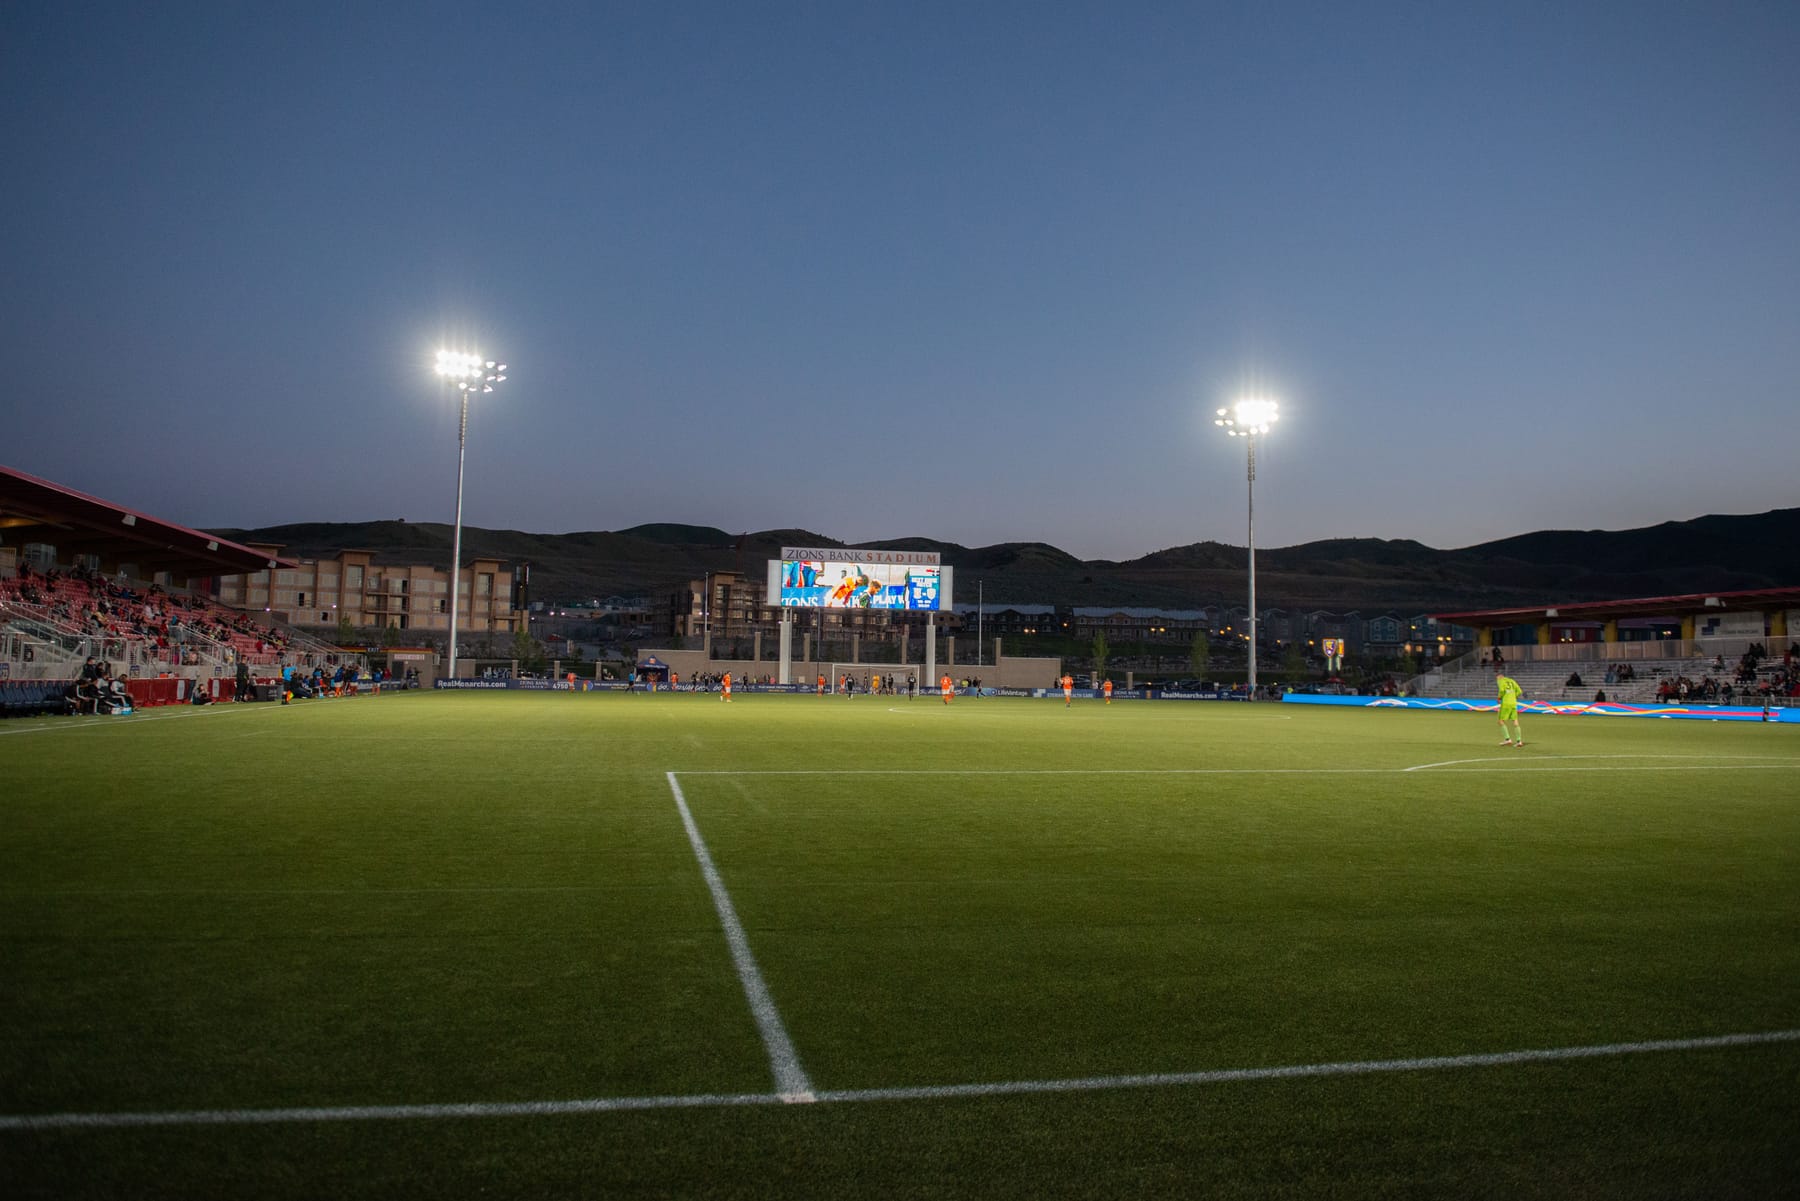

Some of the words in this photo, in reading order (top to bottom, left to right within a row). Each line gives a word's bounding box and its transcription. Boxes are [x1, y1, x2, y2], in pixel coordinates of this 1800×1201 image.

[786, 550, 824, 561] ZIONS
[829, 552, 863, 562] BANK
[866, 553, 938, 564] STADIUM
[437, 680, 507, 688] RealMonarchs.com
[1505, 681, 1515, 690] 31
[996, 689, 1028, 697] LifeVantage
[1160, 691, 1218, 699] RealMonarchs.com
